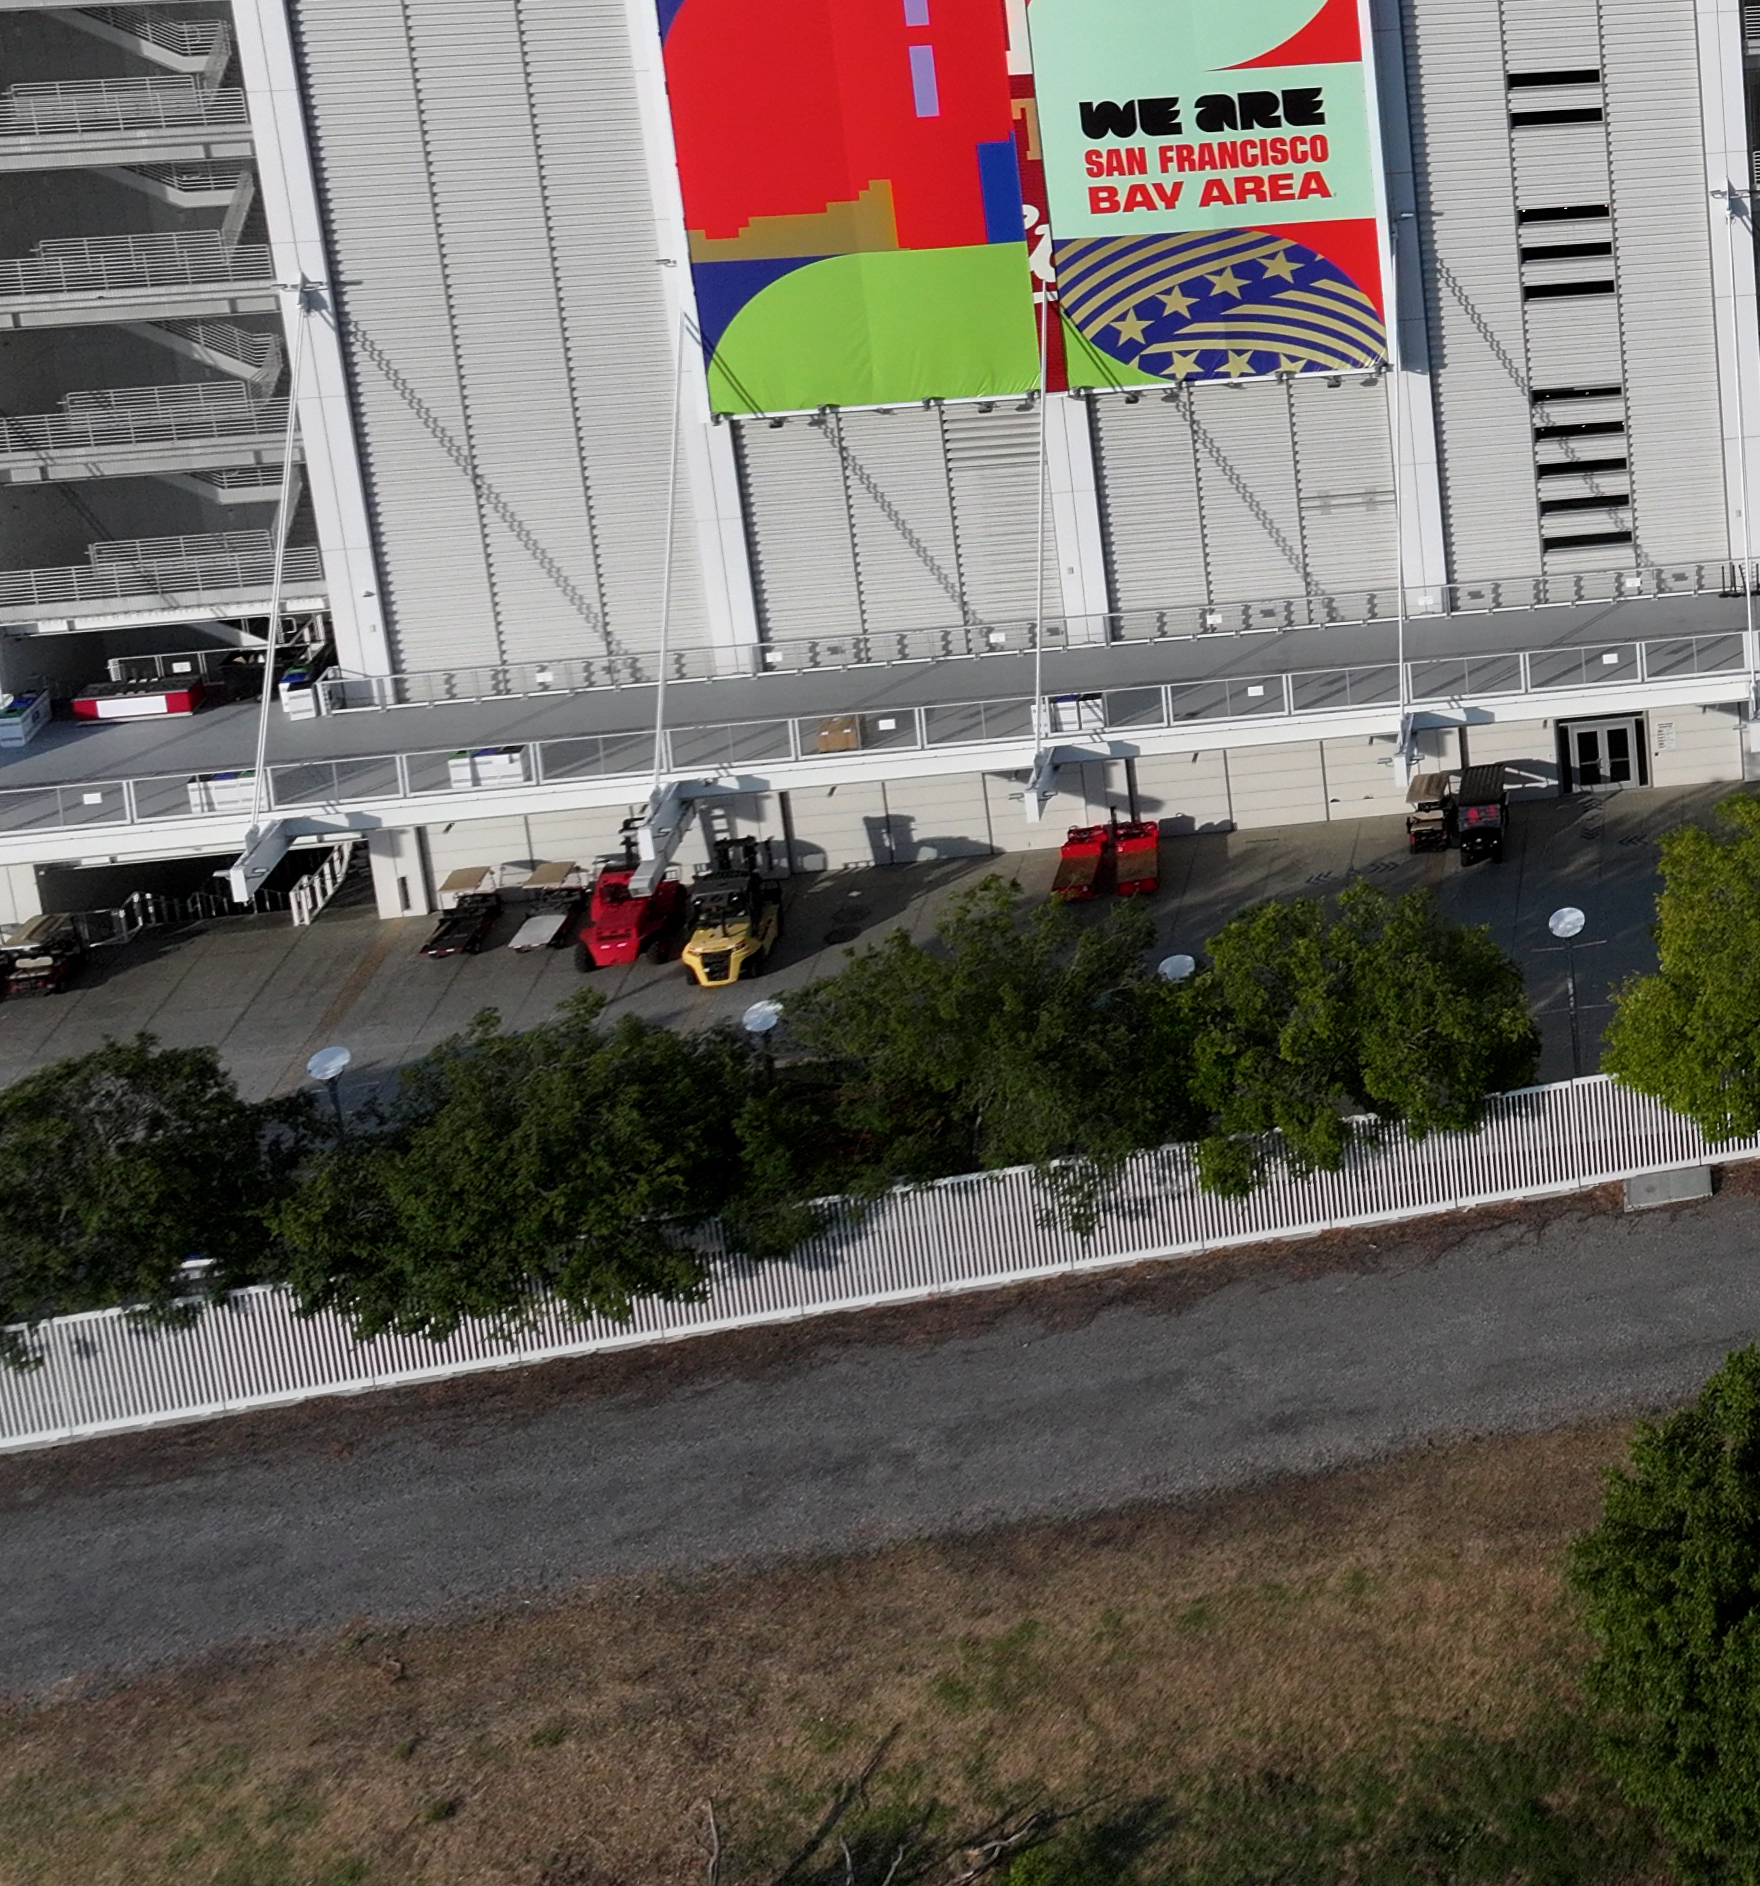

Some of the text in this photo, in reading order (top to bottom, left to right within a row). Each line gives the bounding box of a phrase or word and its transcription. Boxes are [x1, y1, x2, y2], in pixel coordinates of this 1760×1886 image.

[1079, 98, 1184, 139] WE
[1085, 134, 1329, 178] SAN FRANCISCO
[1088, 171, 1333, 215] BAY AREA
